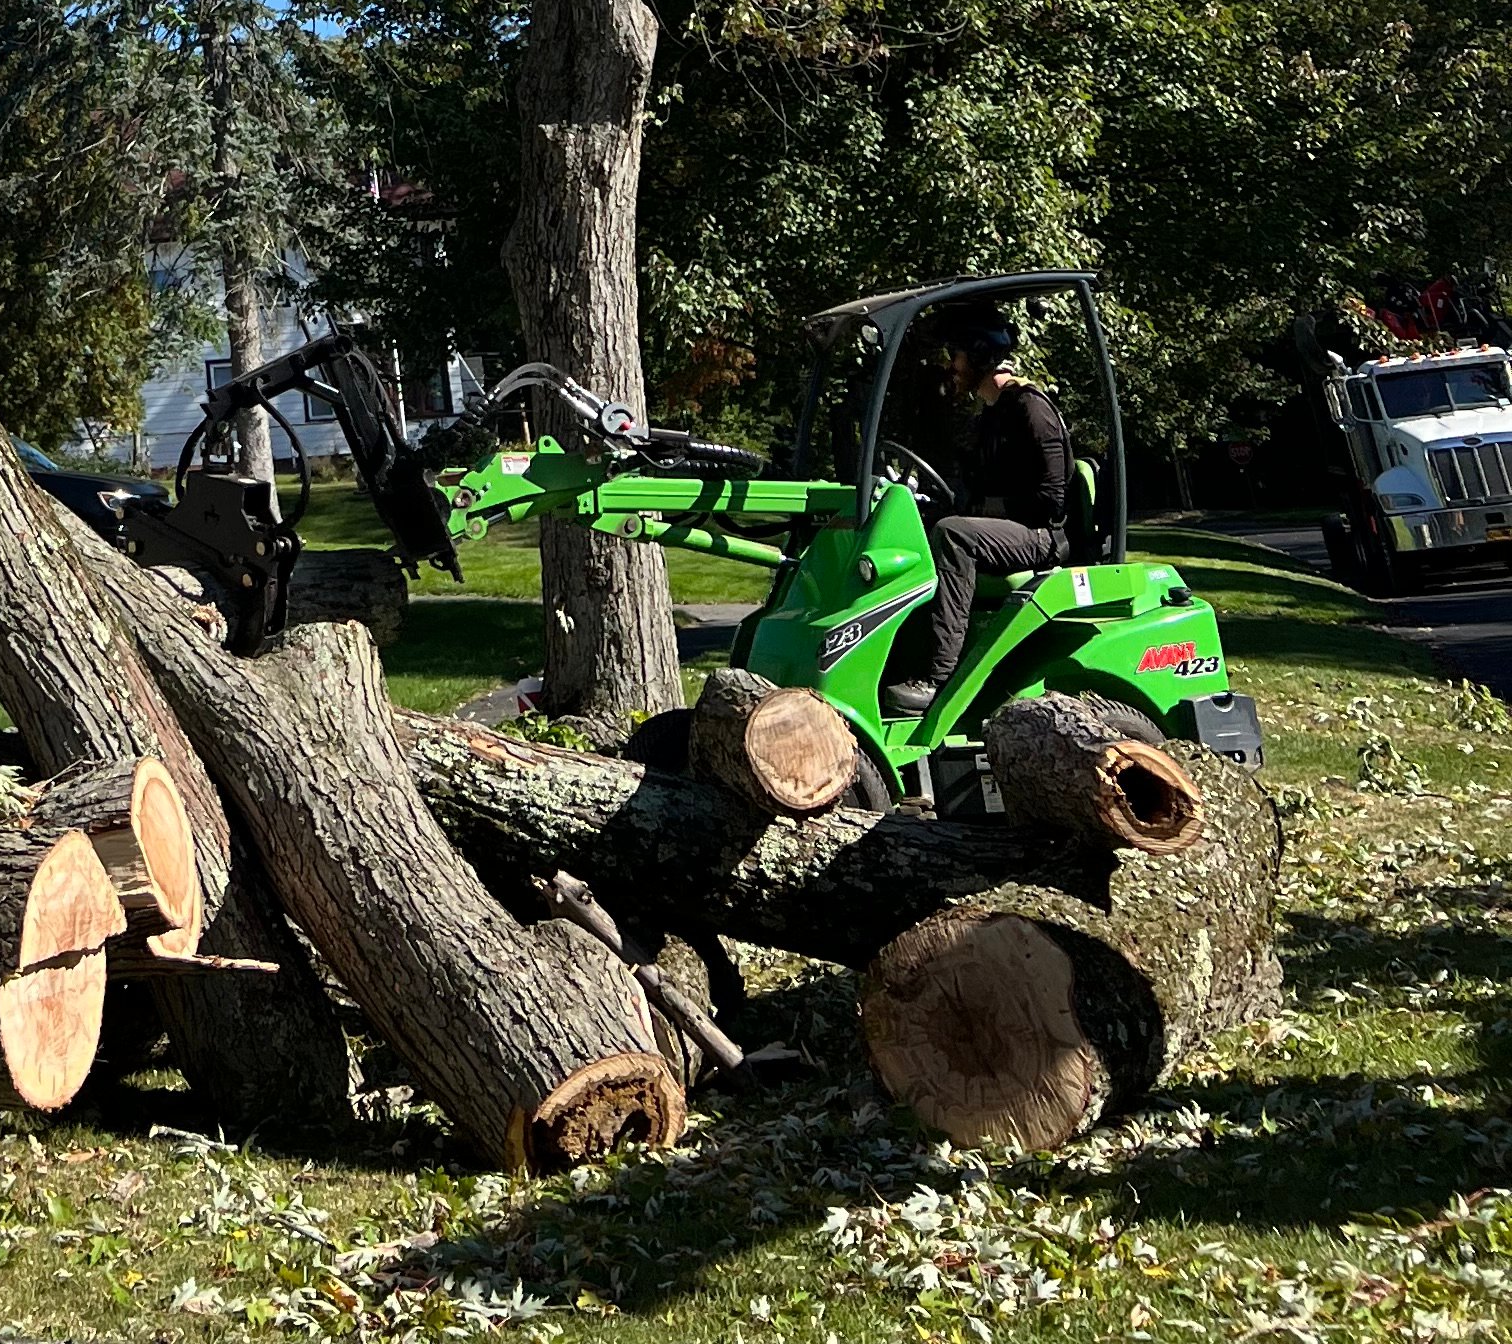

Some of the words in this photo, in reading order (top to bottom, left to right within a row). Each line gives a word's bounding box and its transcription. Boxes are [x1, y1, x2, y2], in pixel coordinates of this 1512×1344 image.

[821, 622, 863, 658] 23
[1136, 640, 1196, 673] AVANT
[1173, 656, 1219, 676] 423
